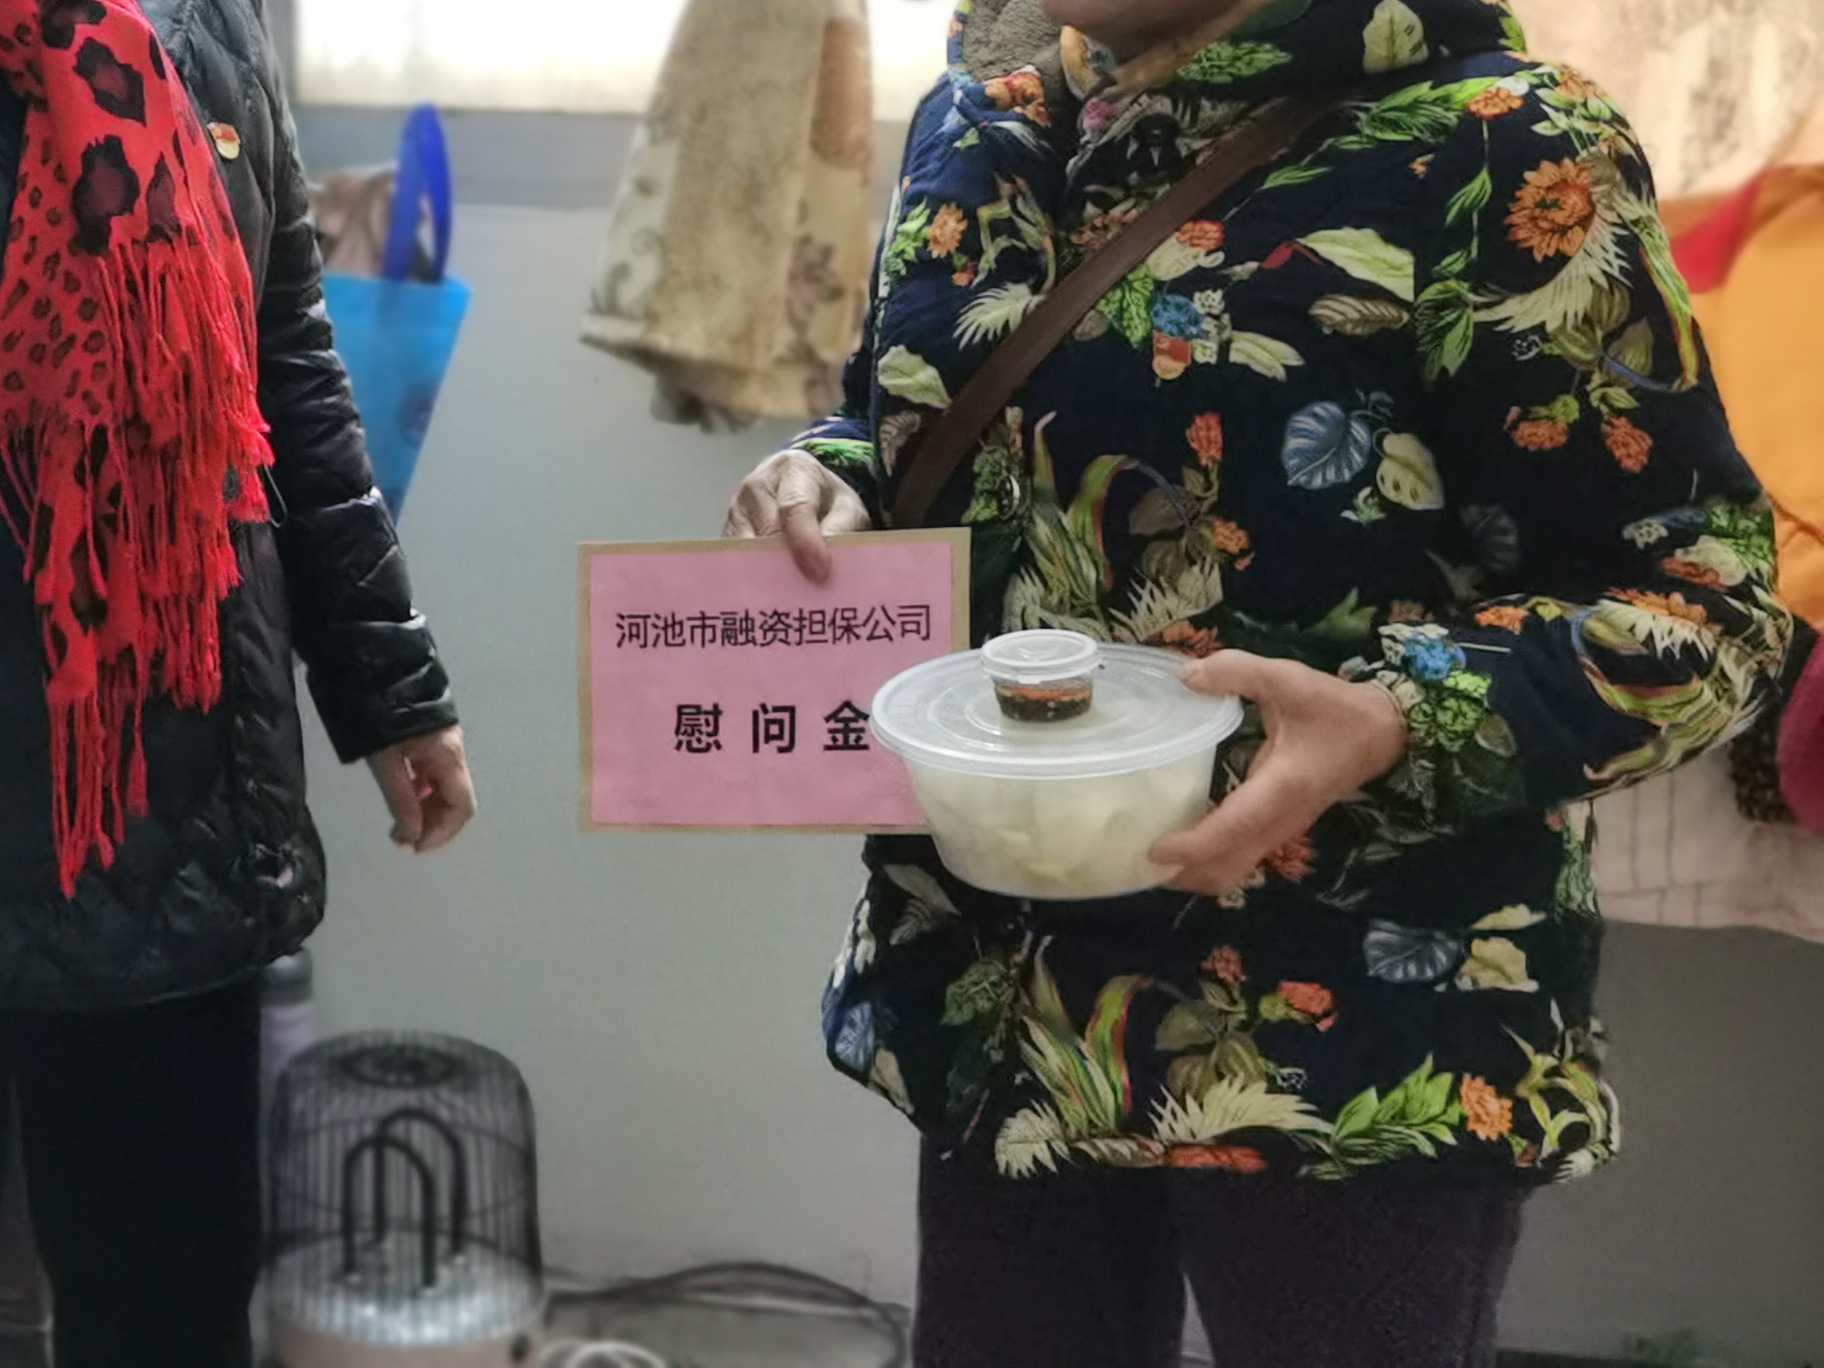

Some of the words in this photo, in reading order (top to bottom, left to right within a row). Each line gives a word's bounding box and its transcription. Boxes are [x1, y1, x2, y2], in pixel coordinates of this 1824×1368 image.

[615, 603, 932, 650] 河池市融资担保公司
[673, 699, 871, 754] 慰问金
